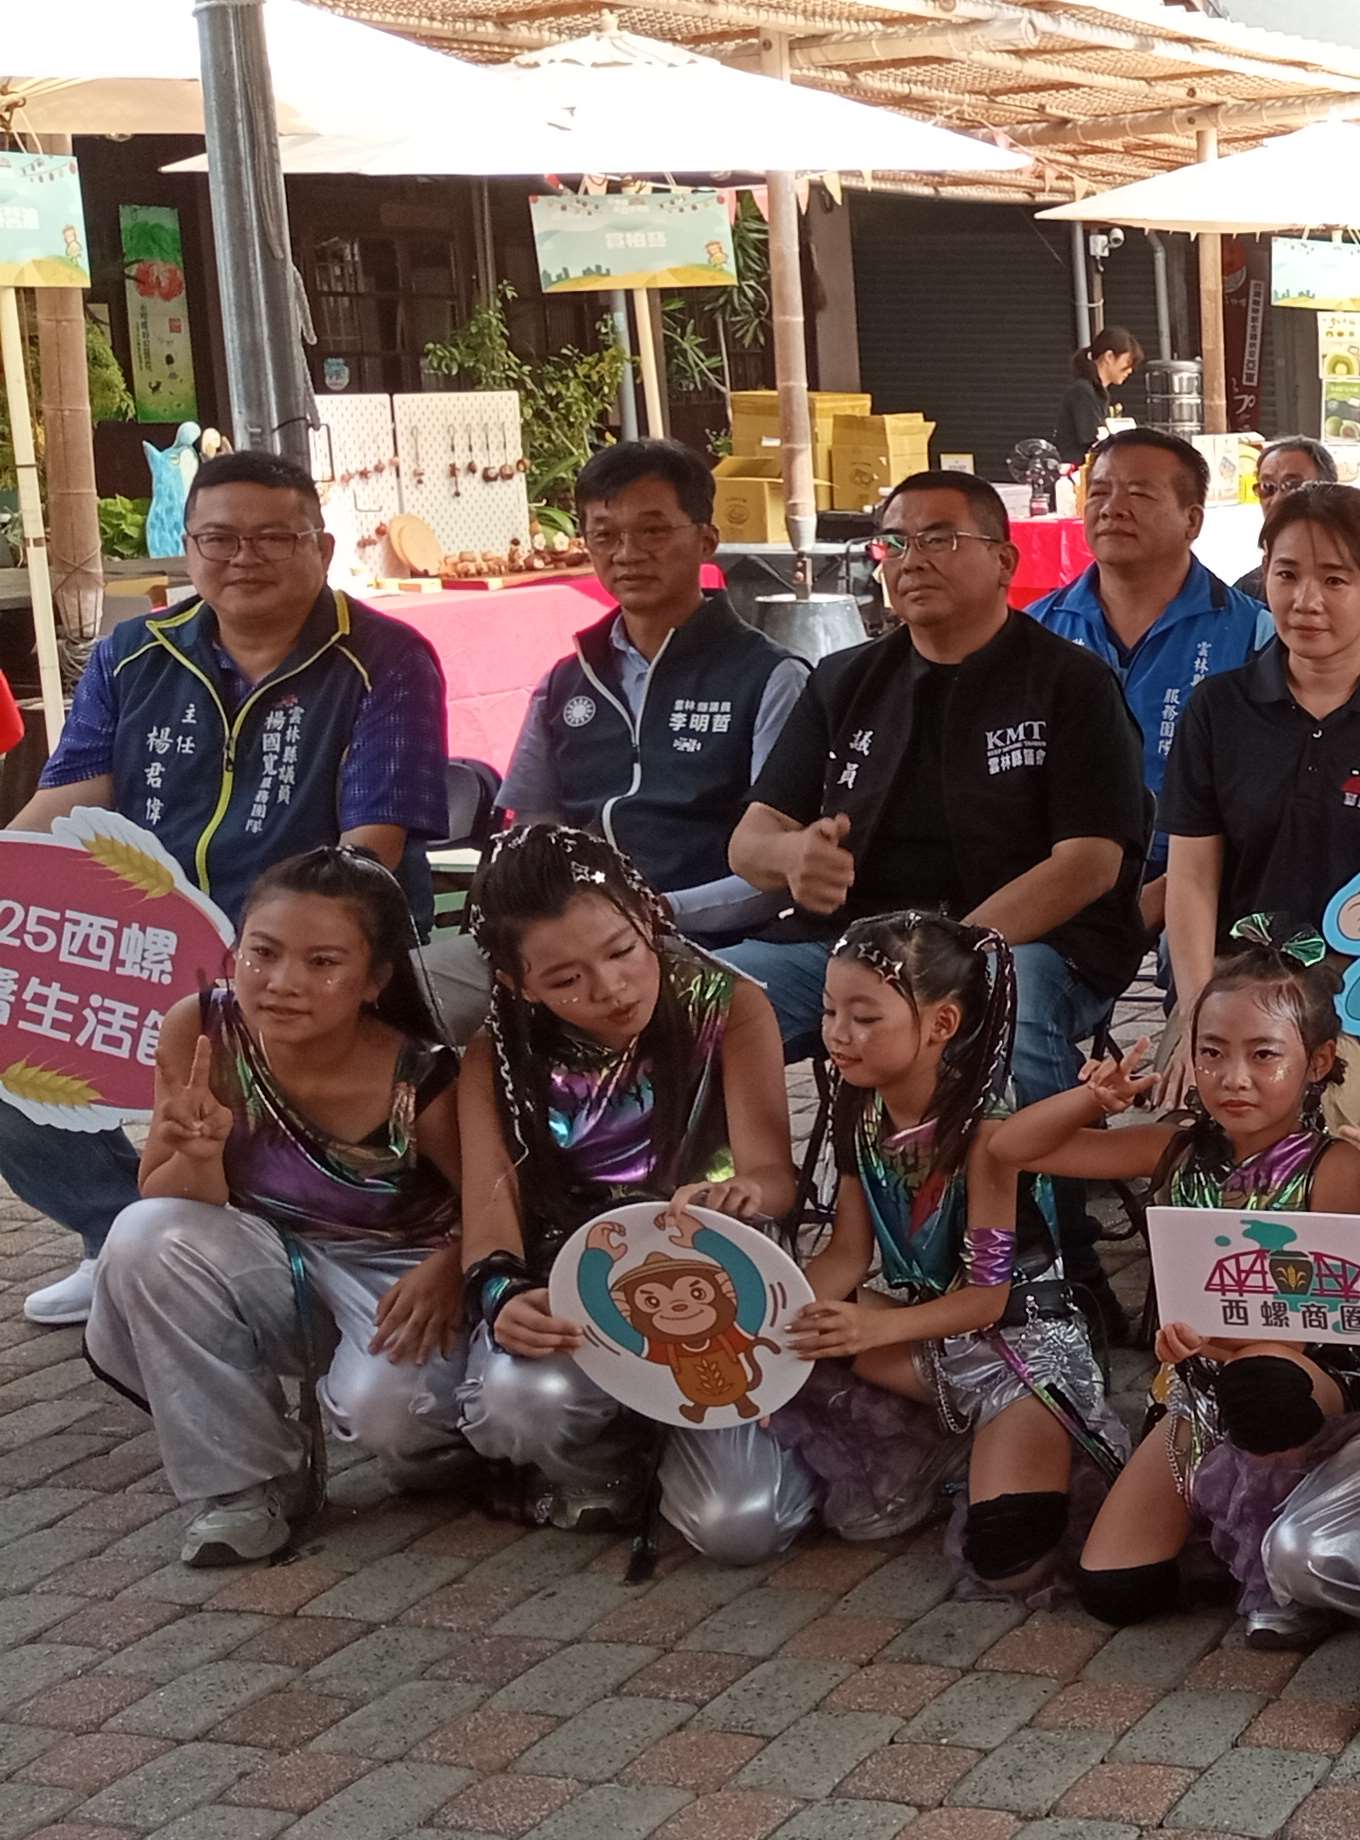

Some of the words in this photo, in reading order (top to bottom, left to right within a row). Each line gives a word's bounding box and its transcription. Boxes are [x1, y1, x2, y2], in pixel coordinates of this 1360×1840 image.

[177, 704, 196, 754] 主任
[669, 713, 731, 732] 李明哲
[985, 721, 1046, 750] KMT
[277, 706, 304, 805] 雲林縣議員
